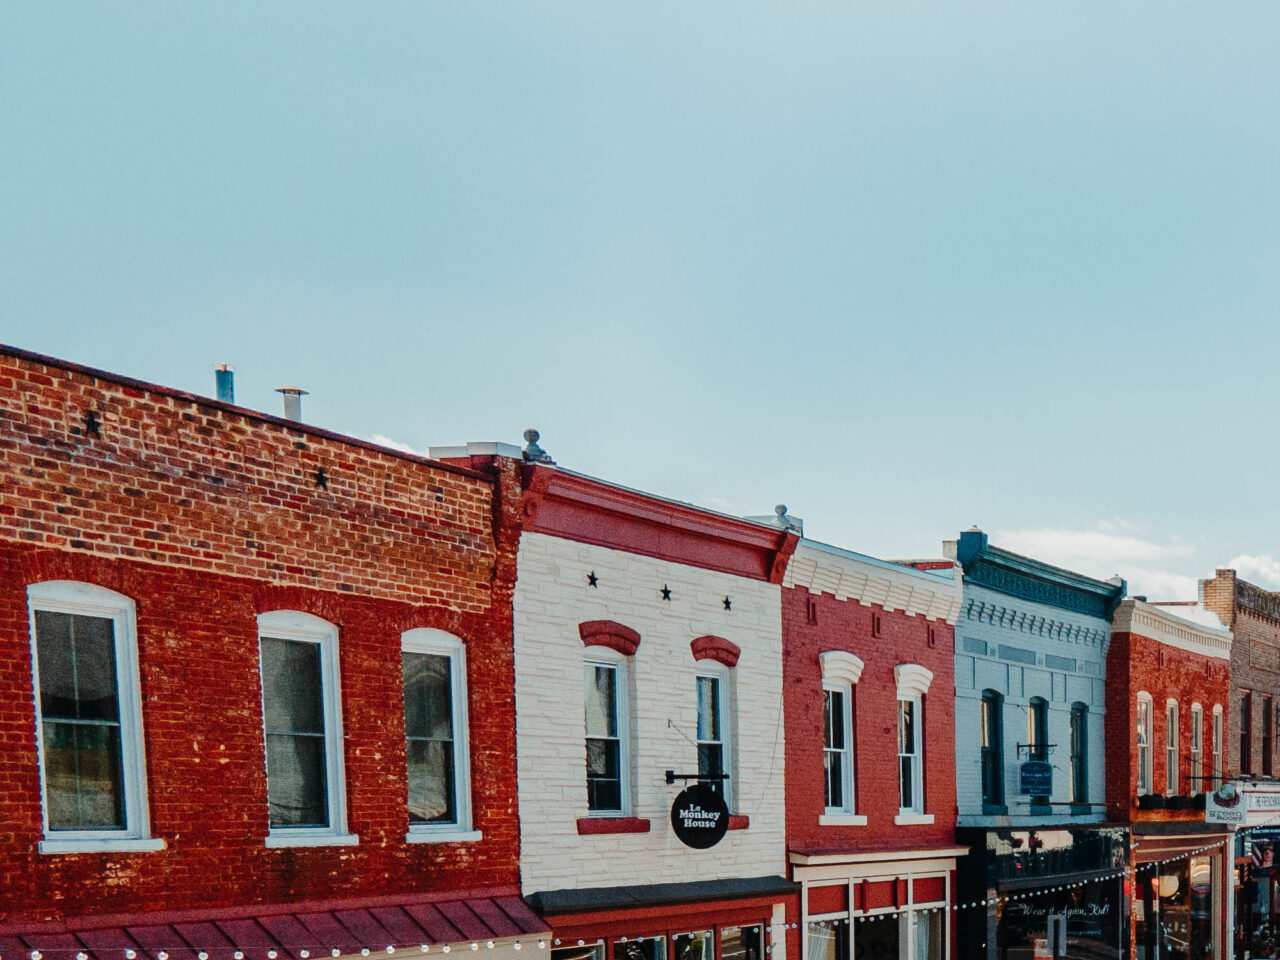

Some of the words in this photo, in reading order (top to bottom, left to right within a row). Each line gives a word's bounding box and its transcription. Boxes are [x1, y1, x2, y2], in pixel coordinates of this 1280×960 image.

[689, 803, 702, 811] Le
[679, 809, 721, 820] Monkey
[1209, 810, 1242, 818] green
[684, 819, 716, 828] House
